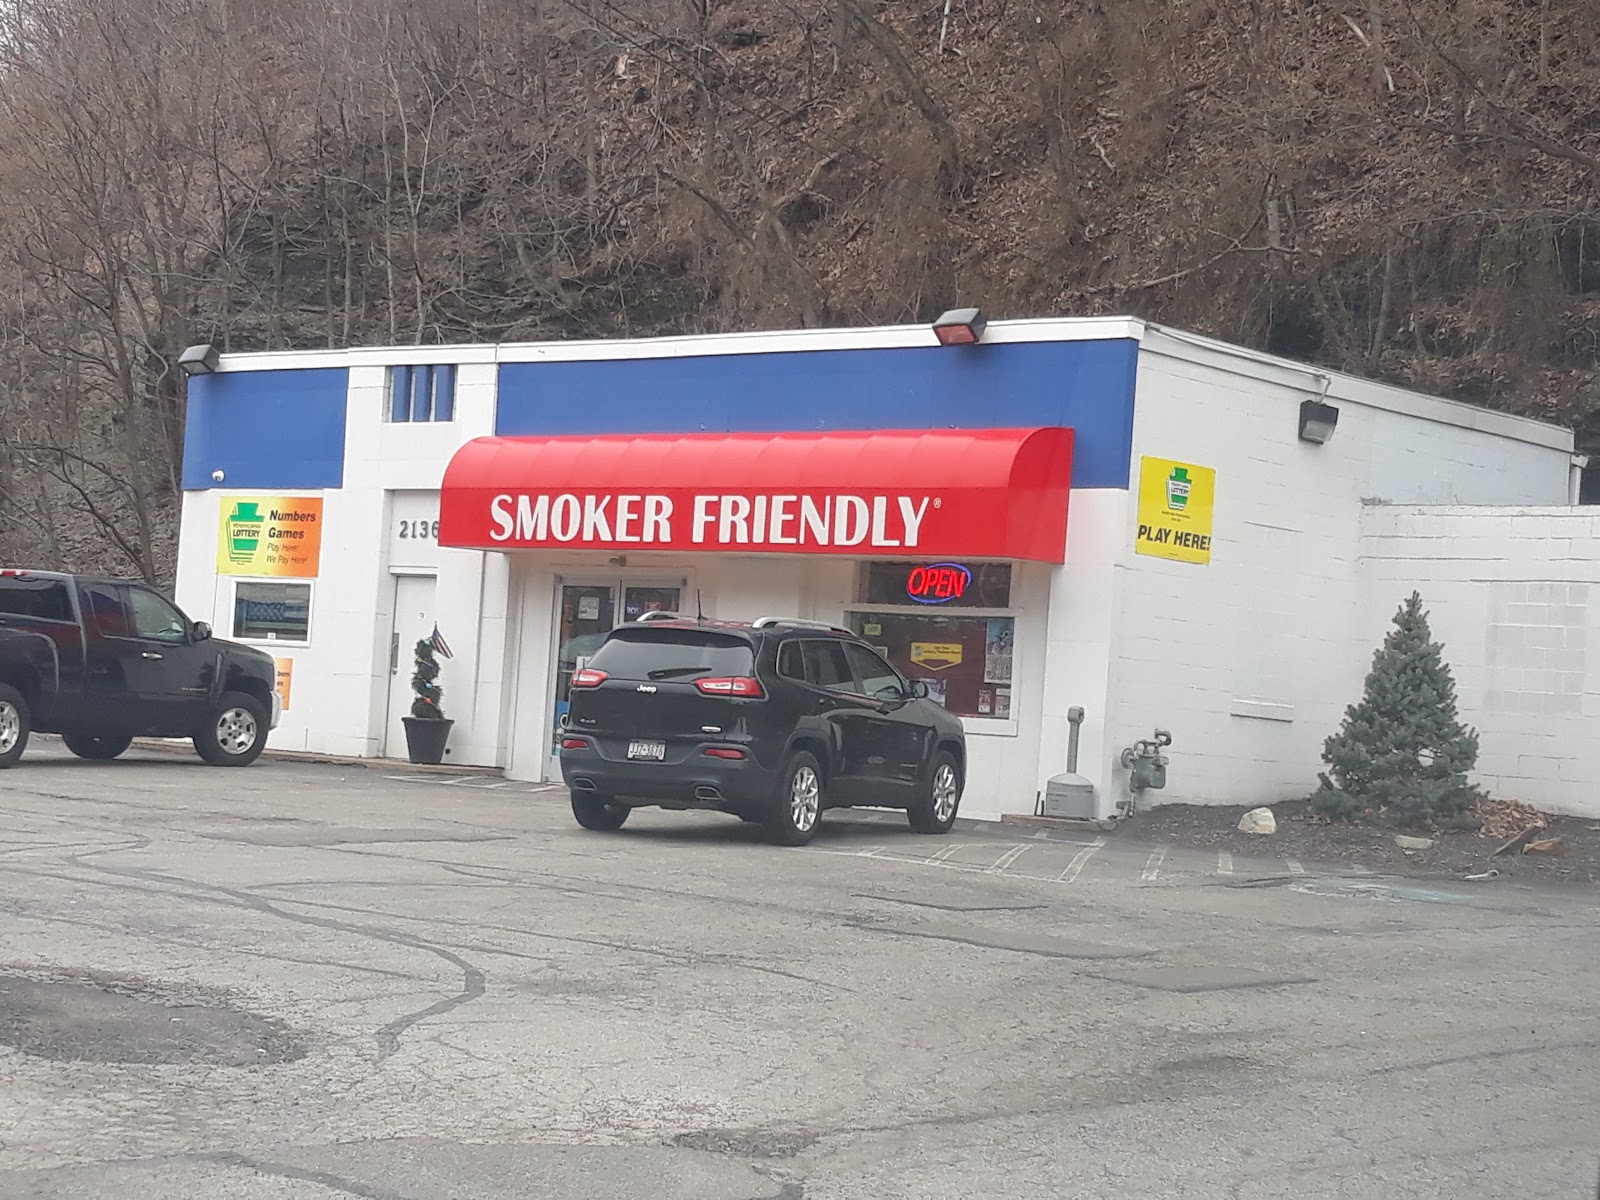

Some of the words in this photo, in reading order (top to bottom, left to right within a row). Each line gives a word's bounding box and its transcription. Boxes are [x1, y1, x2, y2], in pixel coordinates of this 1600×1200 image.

[269, 509, 316, 522] Numbers
[489, 493, 674, 543] SMOKER
[233, 529, 260, 538] LOTTERY
[268, 527, 304, 539] Games
[399, 520, 438, 539] 2136
[1137, 525, 1172, 544] PLAY
[1173, 530, 1212, 551] HERE!
[266, 542, 279, 553] Play
[266, 555, 276, 563] We
[277, 555, 289, 566] Pay
[908, 566, 966, 598] OPEN
[636, 684, 657, 694] Jeep
